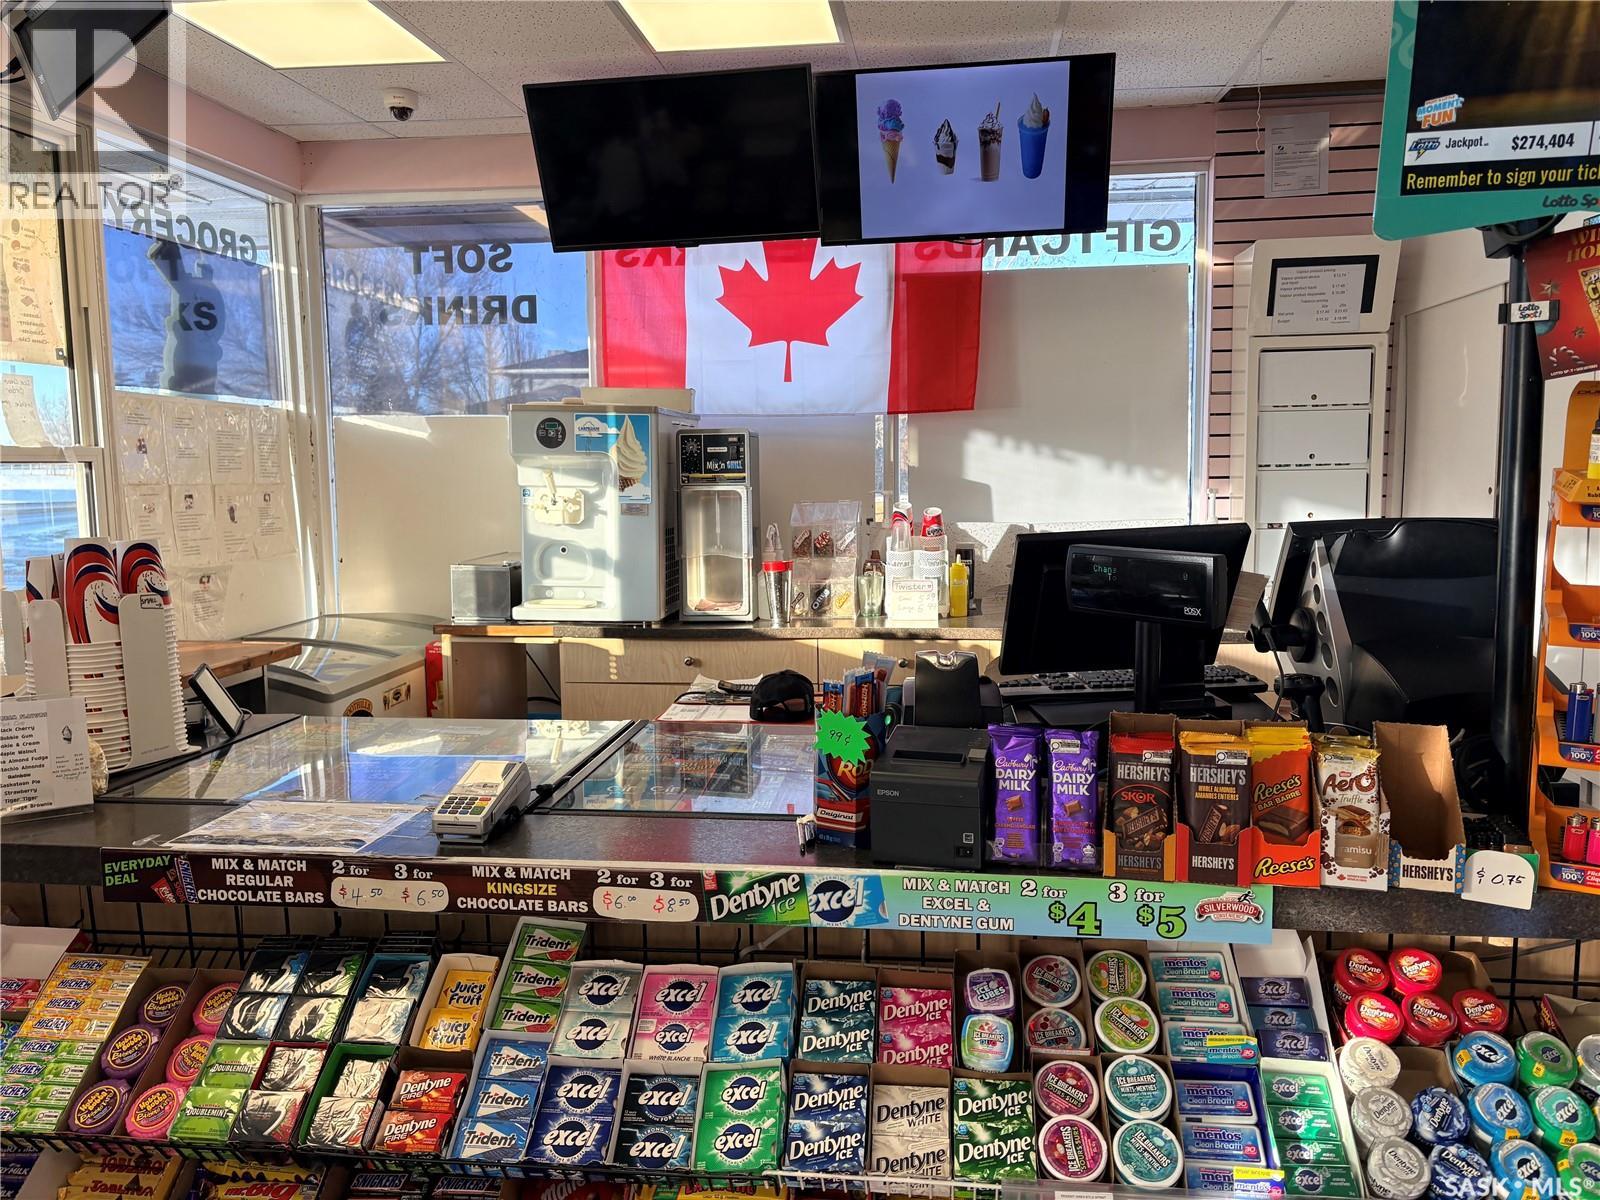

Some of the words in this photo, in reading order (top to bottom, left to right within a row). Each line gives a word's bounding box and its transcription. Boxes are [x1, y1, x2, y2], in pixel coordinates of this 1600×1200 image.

[1421, 109, 1455, 128] FUN
[1512, 133, 1575, 150] $274,404
[1406, 169, 1483, 189] Remember
[1487, 169, 1501, 185] to
[1506, 170, 1536, 187] sign
[1540, 169, 1574, 185] your
[1543, 194, 1578, 207] Lotto
[1518, 303, 1540, 313] Lotto
[1518, 311, 1543, 320] Spot!
[31, 755, 48, 763] Fudge
[994, 754, 1031, 770] Cadbury
[1052, 760, 1089, 774] Cadbury
[995, 767, 1037, 782] DAIRY
[1052, 772, 1095, 787] DAIRY
[1117, 764, 1170, 783] HERSHEY'S
[1190, 766, 1247, 785] HERSHEY'S
[4, 788, 38, 797] Strawberry
[877, 789, 900, 798] EPSON
[999, 779, 1031, 792] MILK
[1056, 783, 1090, 796] MILK
[1254, 775, 1302, 802] Reese's
[1121, 791, 1158, 805] SKOR
[1275, 790, 1302, 805] BARRE
[1338, 793, 1364, 804] Truffle
[819, 809, 854, 821] Original
[104, 855, 171, 874] EVERYDAY
[211, 857, 240, 870] MIX
[243, 858, 254, 870] &
[257, 859, 306, 872] MATCH
[331, 860, 345, 875] 2
[349, 865, 370, 877] for
[394, 864, 408, 879] 3
[412, 869, 433, 880] for
[1118, 855, 1162, 870] HERSHEY'S
[1191, 855, 1235, 871] HERSHEY'S
[1254, 856, 1316, 877] Reese's
[105, 872, 138, 887] DEAL
[226, 874, 294, 887] REGULAR
[472, 865, 501, 879] MIX
[504, 866, 516, 879] &
[520, 867, 571, 881] MATCH
[598, 869, 612, 884] 2
[616, 874, 639, 886] for
[650, 872, 665, 888] 3
[671, 876, 692, 888] for
[1402, 864, 1454, 881] HERSHEY'S
[487, 882, 557, 896] KINGSIZE
[902, 877, 934, 891] MIX
[937, 878, 950, 892] &
[959, 880, 1010, 894] MATCH
[1020, 879, 1038, 897] 2
[1042, 886, 1067, 899] for
[1108, 882, 1128, 903] 3
[1134, 887, 1165, 903] for
[197, 888, 282, 903] CHOCOLATE
[285, 890, 324, 903] BARS
[710, 873, 801, 921] Dentyne
[807, 875, 863, 914] excel
[457, 897, 545, 911] CHOCOLATE
[547, 899, 588, 913] BARS
[922, 896, 973, 911] EXCEL
[977, 898, 990, 912] &
[1203, 903, 1255, 915] SILVERWOOD
[898, 914, 973, 929] DENTYNE
[975, 916, 1014, 931] GUM
[1048, 901, 1102, 936] $4
[1136, 905, 1187, 939] $5
[1401, 960, 1432, 975] Dentyne
[512, 971, 560, 987] Trident
[450, 981, 486, 995] Juicy
[977, 987, 1006, 1002] CUBES
[1171, 989, 1216, 999] mentos
[448, 992, 482, 1006] Fruit
[1191, 998, 1217, 1007] Breath
[1413, 1003, 1447, 1020] Dentyne
[566, 1020, 619, 1041] excel
[655, 1028, 693, 1045] excel
[1034, 1031, 1045, 1041] ICE
[1045, 1027, 1075, 1039] BREAKERS
[802, 1028, 870, 1053] Dentyne
[846, 1041, 863, 1053] ICE
[1275, 1036, 1309, 1049] excel
[492, 1052, 541, 1068] Trident
[883, 1044, 949, 1065] Dentyne
[1471, 1043, 1508, 1063] excel
[6, 1064, 46, 1076] HI-CHEW
[1116, 1076, 1126, 1085] ICE
[1126, 1073, 1157, 1084] BREAKERS
[557, 1076, 612, 1099] excel
[637, 1084, 693, 1106] excel
[1047, 1073, 1059, 1085] ICE
[1057, 1077, 1089, 1102] BREAKERS
[187, 1108, 229, 1118] DOUBLEMINT
[1373, 1099, 1396, 1119] Dentyne
[1429, 1097, 1450, 1128] Dentyne
[383, 1115, 437, 1138] Dentyne
[907, 1114, 942, 1128] WHITE
[1279, 1115, 1305, 1126] excel
[384, 1130, 408, 1143] FIRE
[464, 1129, 517, 1147] Trident
[715, 1128, 761, 1150] excel
[1193, 1131, 1241, 1141] mentos
[790, 1132, 860, 1161] Dentyne
[959, 1136, 1031, 1164] Dentyne
[1215, 1141, 1243, 1150] Breath
[835, 1149, 854, 1161] ICE
[876, 1148, 946, 1175] Dentyne
[1516, 1152, 1542, 1179] excel
[354, 1174, 407, 1190] SNICKERS
[435, 1176, 492, 1192] SNICKERS
